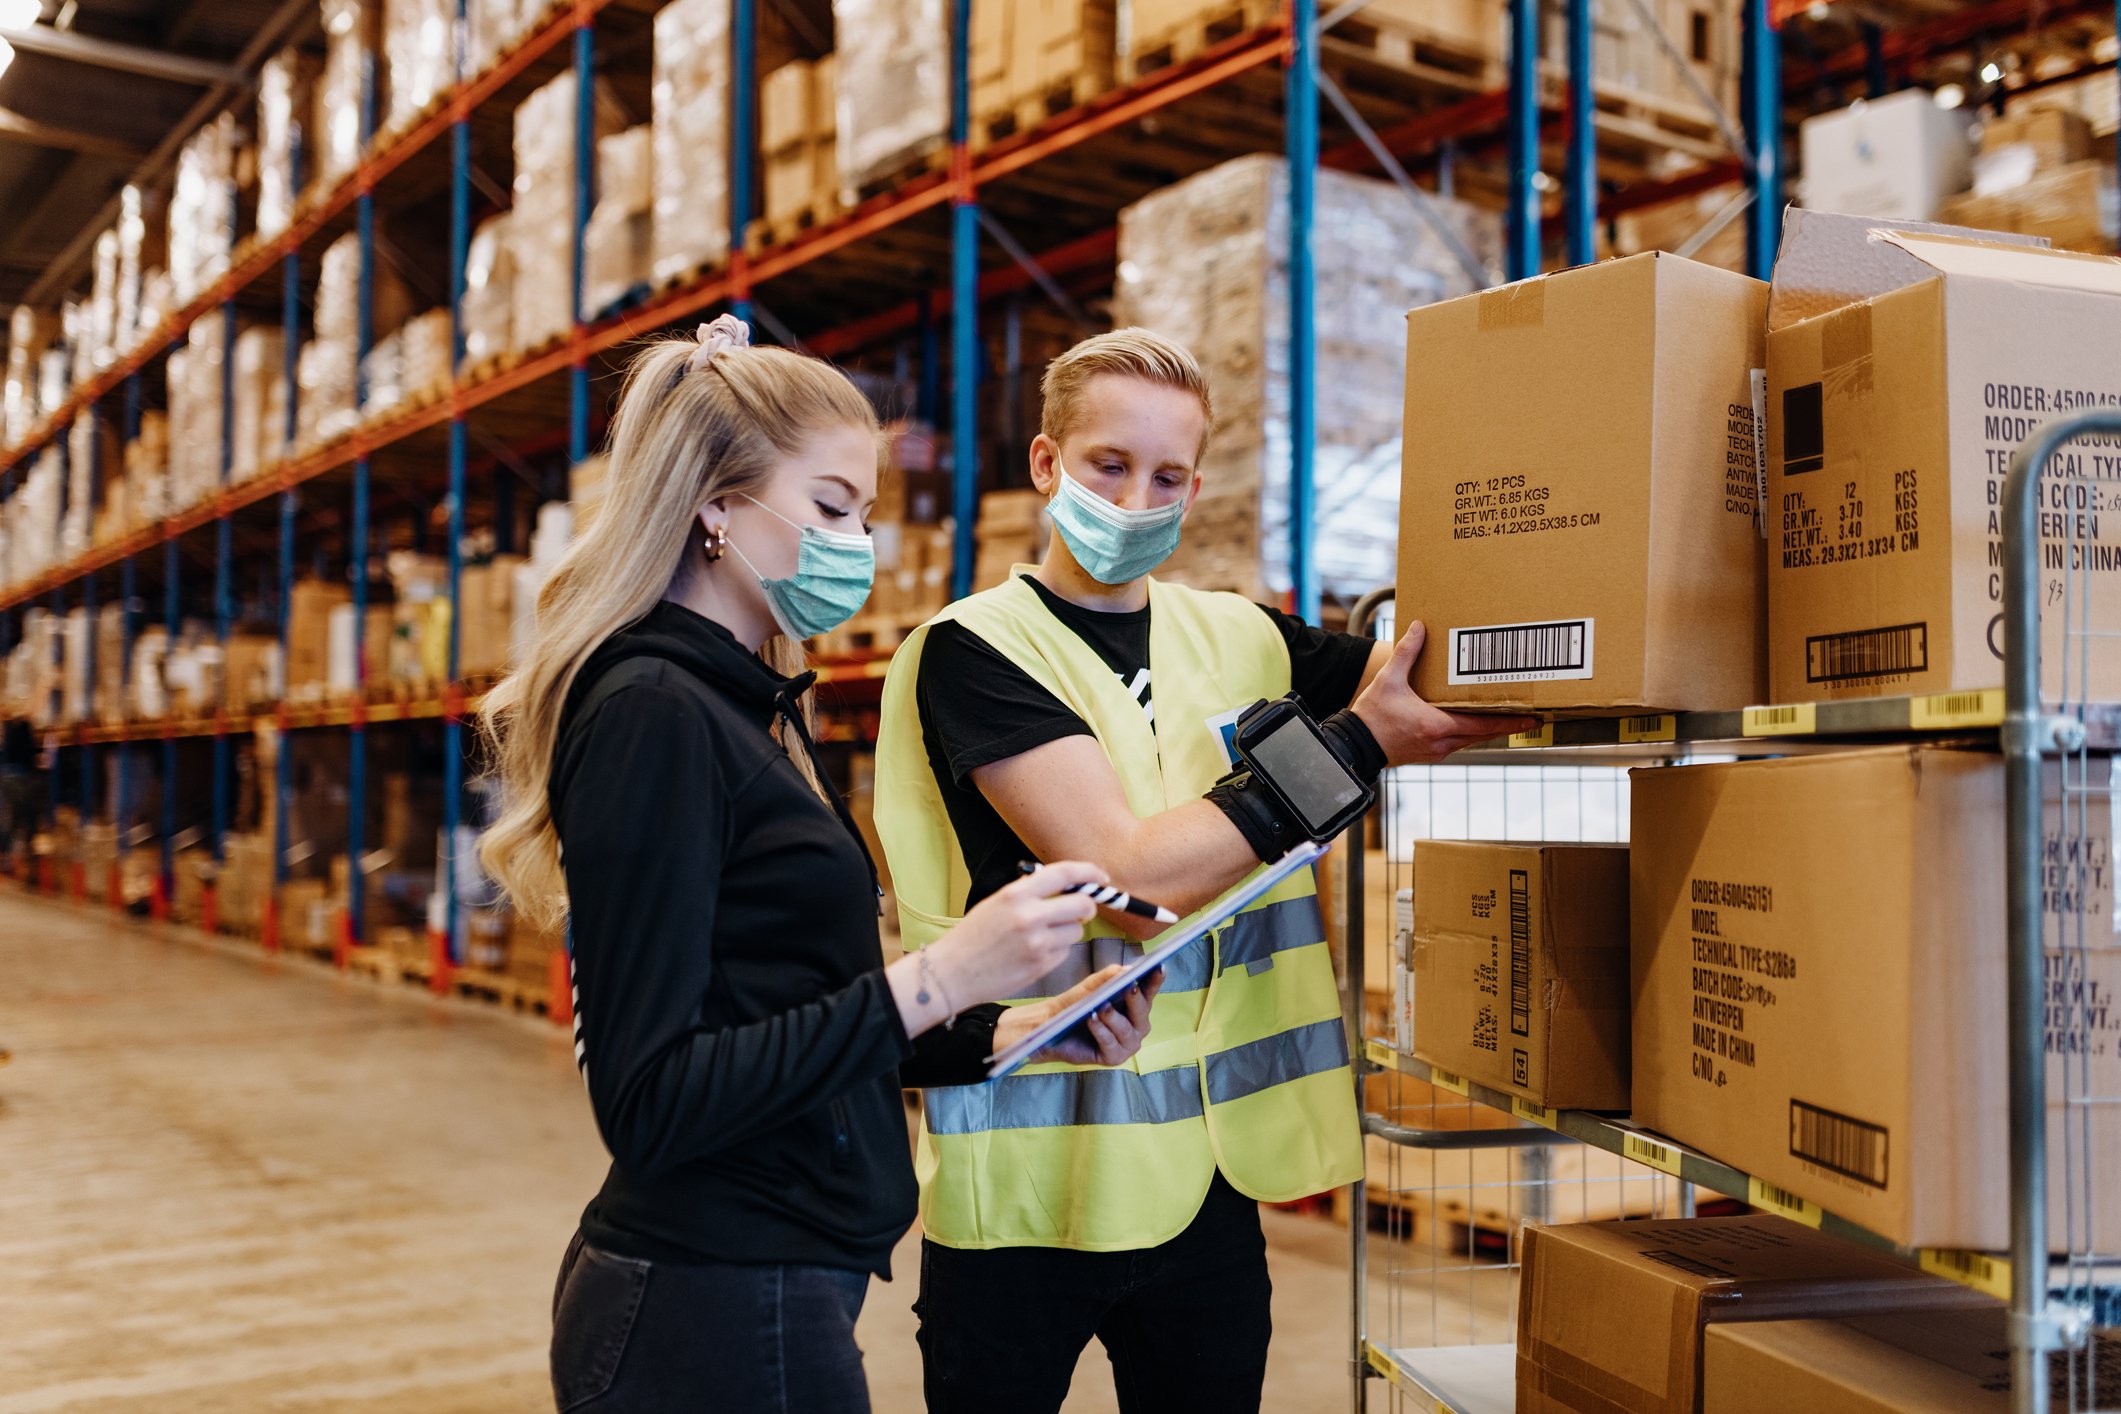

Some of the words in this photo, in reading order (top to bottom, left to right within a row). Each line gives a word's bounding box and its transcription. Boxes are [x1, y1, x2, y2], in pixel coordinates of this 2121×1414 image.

[1456, 481, 1480, 495] QTY:
[1486, 478, 1498, 491] 12
[1502, 475, 1526, 489] PCS
[1726, 483, 1753, 500] MADE
[1784, 492, 1805, 512] QTY:
[1845, 482, 1856, 499] 12
[1895, 470, 1917, 490] PCS
[1455, 495, 1496, 510] GR.WT.:
[1499, 491, 1522, 504] 6.85
[1524, 488, 1550, 502] KGS
[1784, 509, 1822, 530] GR.WT.:
[1840, 500, 1862, 522] 3.70
[1895, 490, 1918, 512] KGS
[1454, 512, 1476, 524] NET
[1478, 509, 1498, 522] WT:
[1501, 507, 1517, 520] 6.0
[1520, 504, 1545, 517] KGS
[1454, 525, 1491, 540] MEAS.:
[1494, 515, 1577, 536] 41.2X29.5X38.5
[1580, 513, 1600, 526] CM
[1784, 528, 1828, 549] NET.WT.:
[1839, 521, 1862, 540] 3.40
[1896, 510, 1918, 532] KGS
[1783, 548, 1820, 568] MEAS.:
[1822, 535, 1896, 565] 29.3X21.3X34
[1901, 531, 1918, 552] CM
[2045, 544, 2063, 569] IN
[1490, 890, 1496, 908] CM
[1692, 937, 1738, 968] TECHNICAL
[1474, 968, 1480, 982] 12
[1692, 967, 1718, 995] BATCH
[1693, 995, 1744, 1032] ANTWERPEN
[1693, 1022, 1716, 1053] MADE
[1718, 1031, 1727, 1057] IN
[1729, 1035, 1755, 1068] CHINA
[1516, 1058, 1526, 1080] 54
